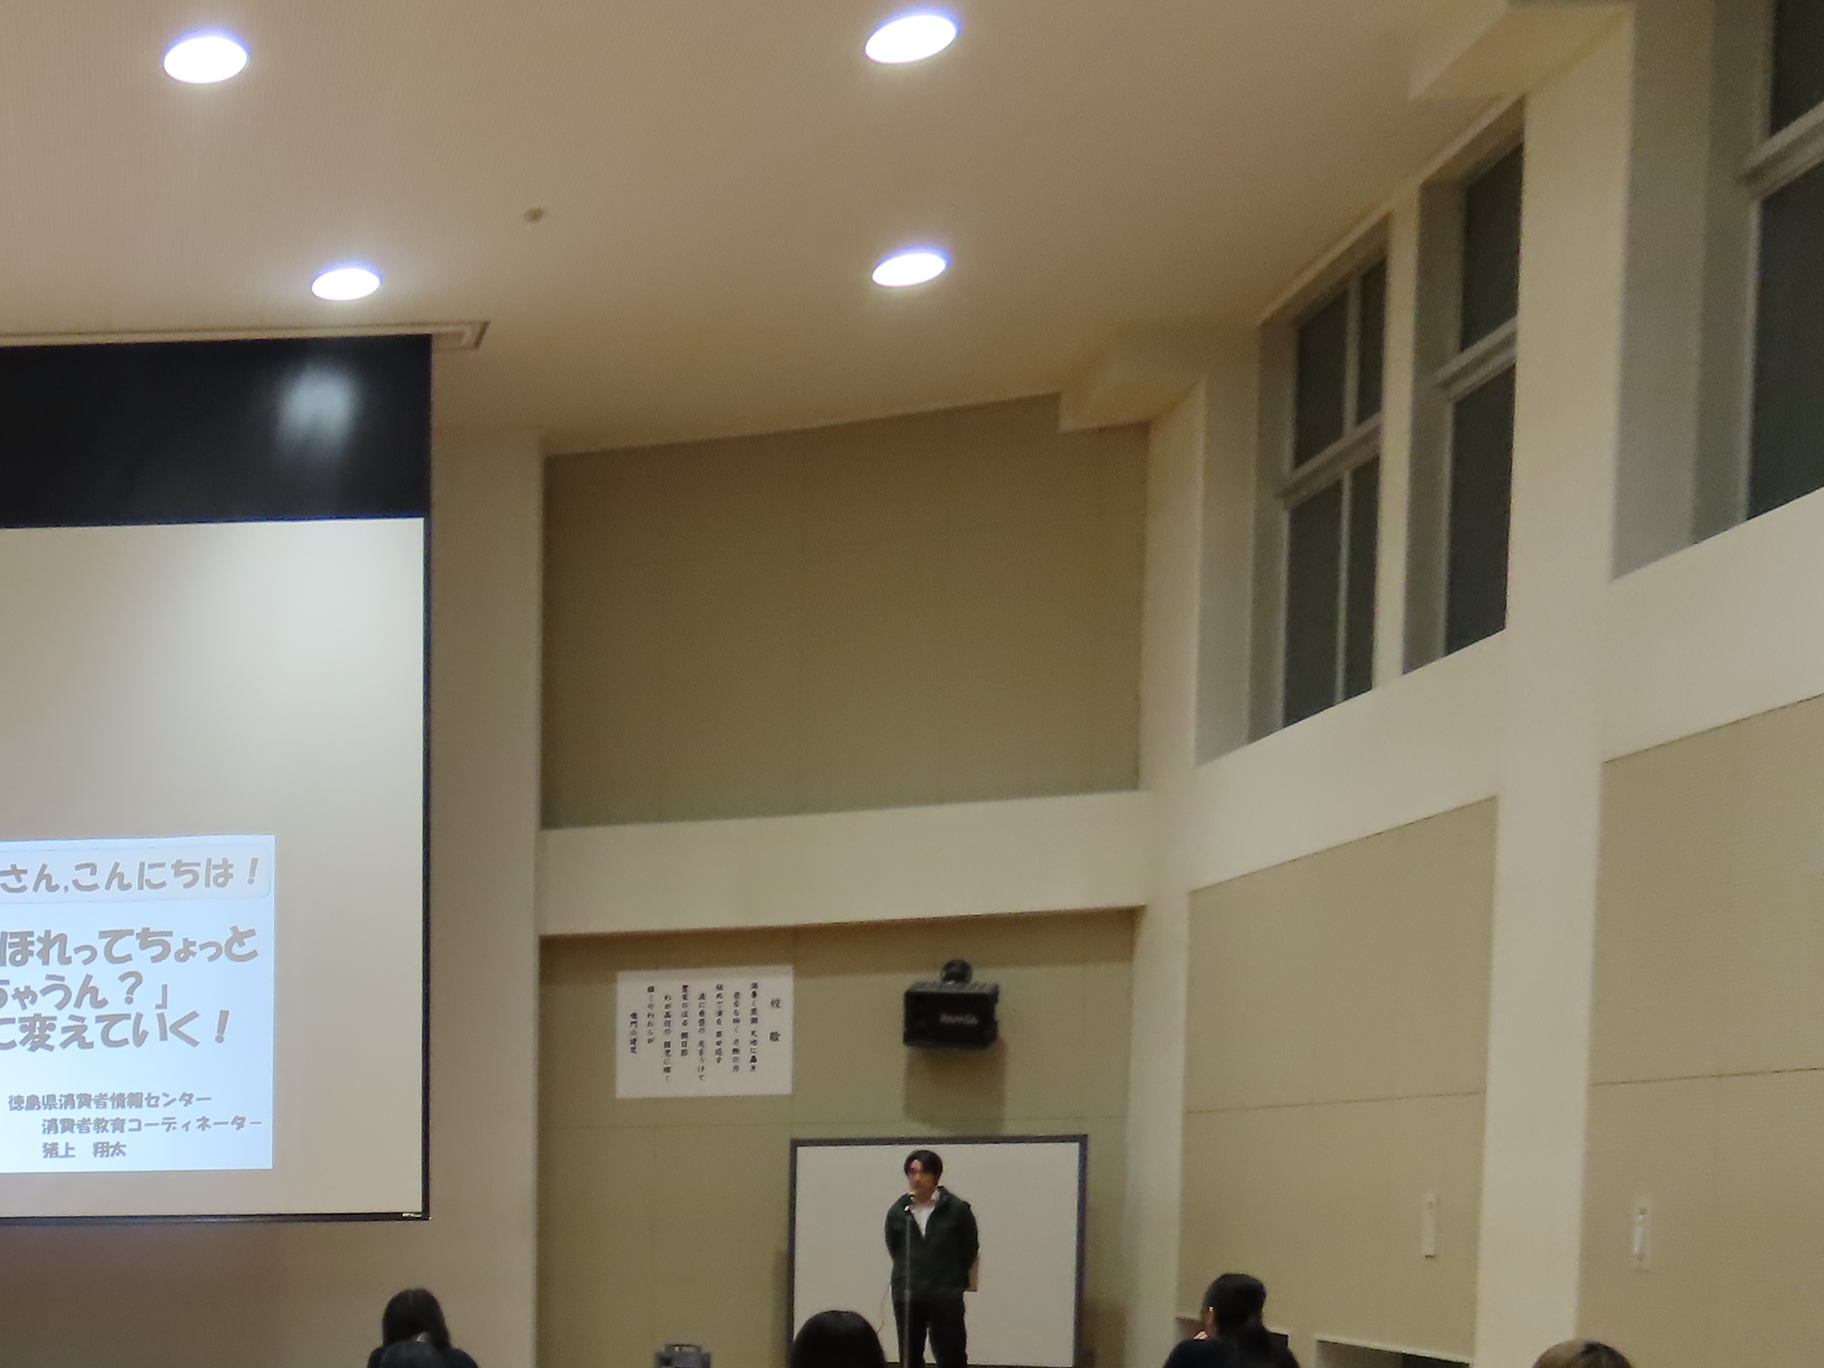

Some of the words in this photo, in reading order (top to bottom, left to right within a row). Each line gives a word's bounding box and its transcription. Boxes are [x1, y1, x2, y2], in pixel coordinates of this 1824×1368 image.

[8, 1091, 212, 1111] 徳島県消費者情報センター
[42, 1115, 263, 1134] 消費者教育コーディネーター
